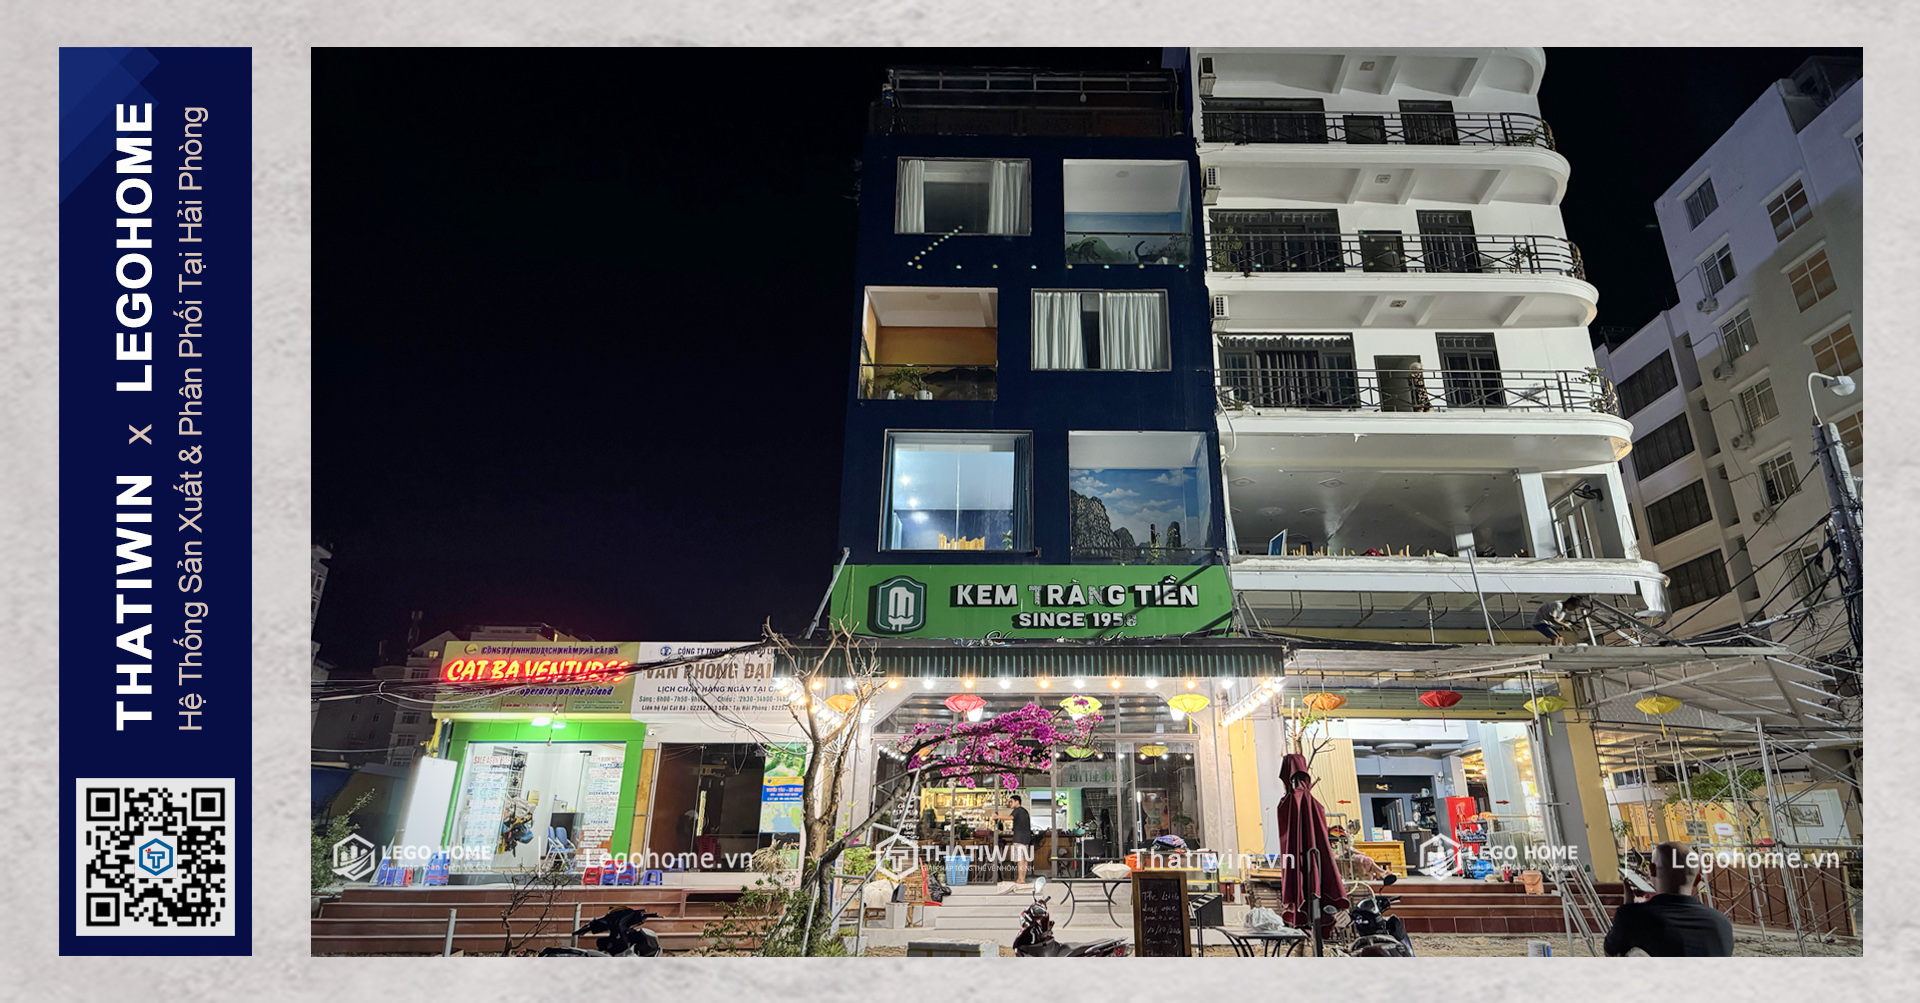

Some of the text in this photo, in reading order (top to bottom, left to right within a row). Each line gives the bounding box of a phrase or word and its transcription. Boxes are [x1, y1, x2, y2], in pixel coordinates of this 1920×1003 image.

[956, 574, 1199, 606] KEM TRÀNG TIỀN
[1018, 612, 1086, 628] SINCE
[446, 659, 488, 681] CAT
[491, 659, 521, 681] BA
[520, 687, 557, 697] operator
[558, 688, 570, 696] on
[571, 687, 586, 696] the
[586, 686, 614, 696] island
